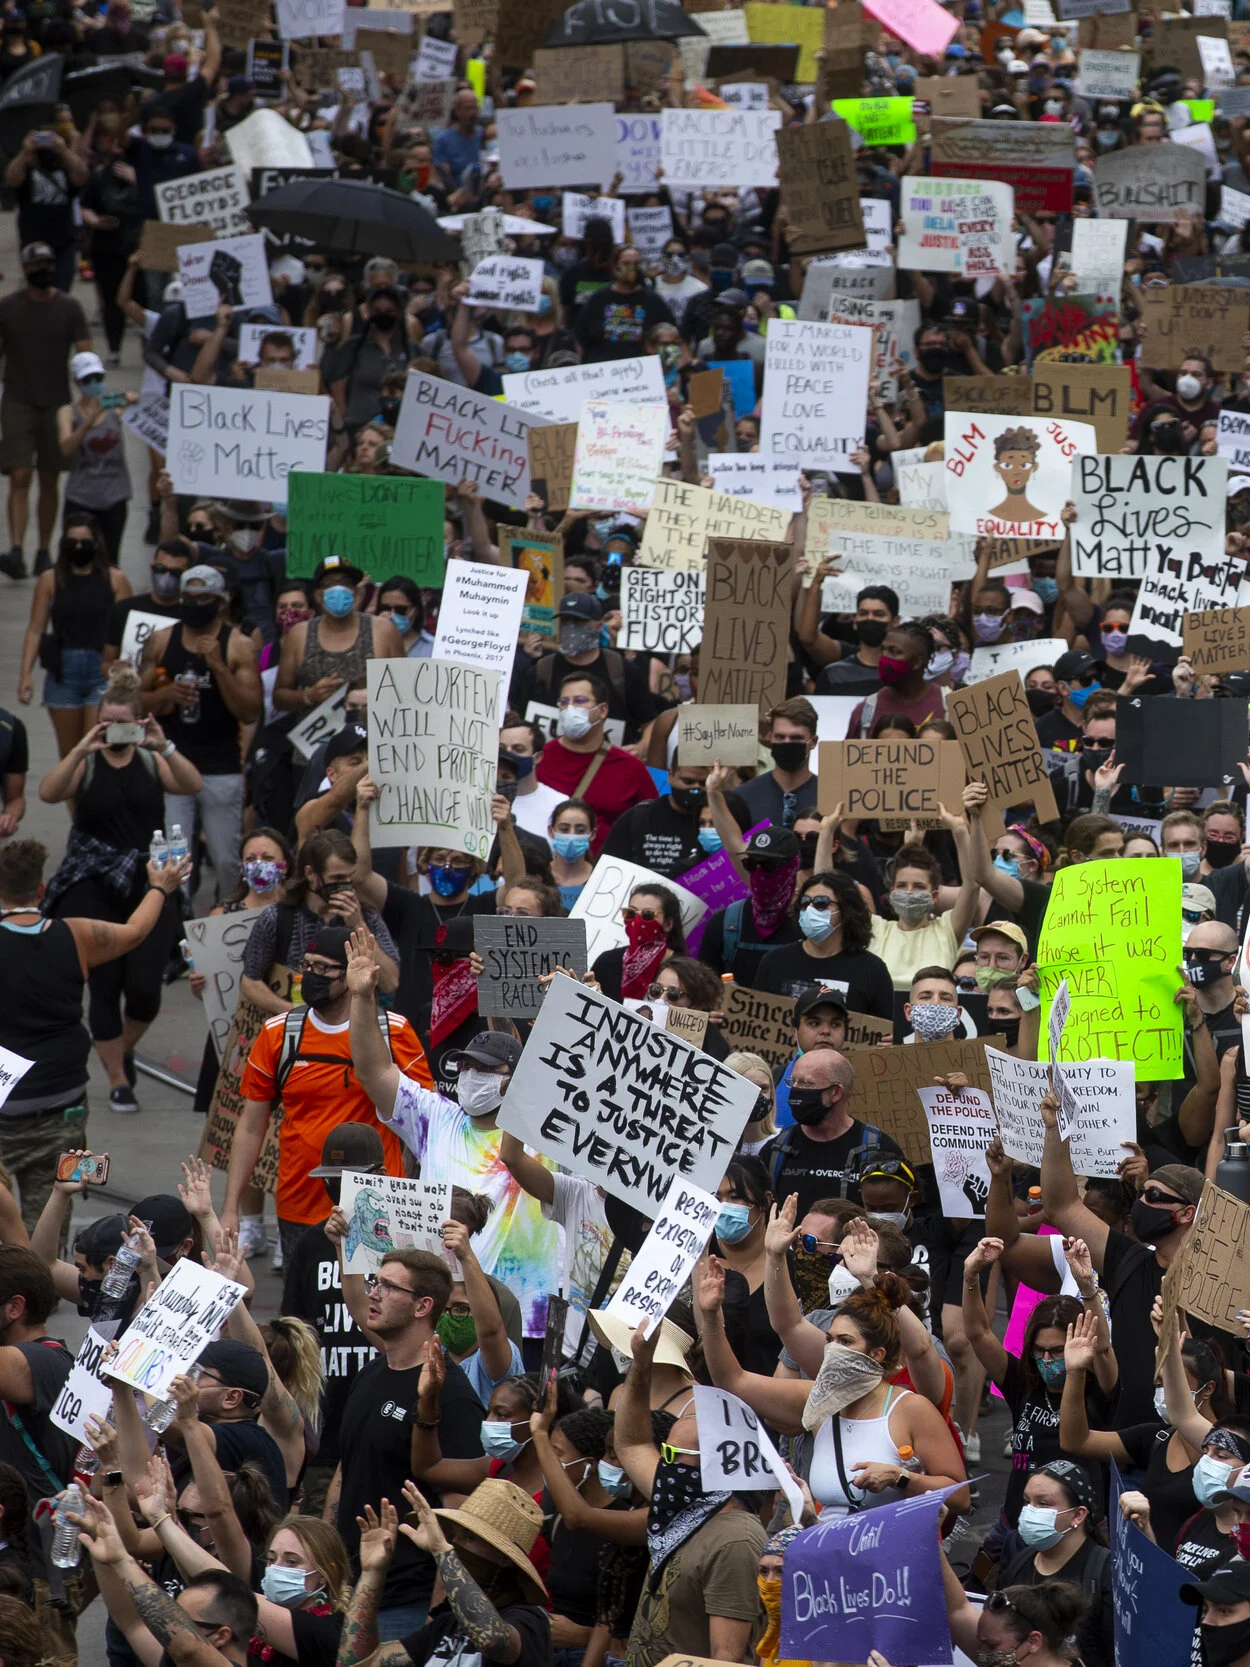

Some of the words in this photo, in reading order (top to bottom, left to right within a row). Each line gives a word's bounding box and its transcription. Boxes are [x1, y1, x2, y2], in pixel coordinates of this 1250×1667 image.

[667, 113, 748, 137] RACISM
[757, 116, 778, 135] IS
[665, 140, 733, 156] LITTLE
[673, 161, 737, 179] ENERGY
[162, 174, 235, 202] GEORGE
[786, 375, 833, 394] PEACE
[782, 403, 825, 417] LOVE
[1034, 383, 1118, 416] BLM
[180, 390, 256, 431] Black
[266, 401, 326, 441] Lives
[772, 433, 865, 454] EQUALITY
[1080, 456, 1207, 496] BLACK
[976, 519, 1058, 537] EQUALITY
[627, 570, 667, 587] GET
[674, 571, 699, 588] ON
[844, 558, 897, 576] ALWAYS
[904, 565, 950, 580] RIGHT
[629, 587, 678, 604] RIGHT
[712, 563, 786, 610] BLACK
[1188, 609, 1243, 630] BLACK
[712, 617, 777, 666] LIVES
[1204, 626, 1245, 642] LIVES
[376, 665, 402, 702] A
[414, 662, 499, 720] CURFEW
[956, 682, 1031, 735] BLACK
[847, 743, 934, 766] DEFUND
[964, 718, 1036, 768] LIVES
[871, 768, 907, 785] THE
[849, 788, 935, 811] POLICE
[1047, 906, 1098, 931] Cannot
[1110, 899, 1149, 927] Fail
[505, 923, 538, 948] END
[669, 1009, 704, 1032] UNITED
[539, 1042, 585, 1079] IS
[597, 1074, 618, 1094] A
[627, 1088, 729, 1158] THREAT
[935, 1093, 981, 1106] DEFUND
[930, 1105, 953, 1116] THE
[955, 1106, 992, 1120] POLICE
[557, 1080, 589, 1113] TO
[597, 1100, 696, 1174] JUSTICE
[931, 1123, 971, 1135] DEFEND
[973, 1125, 997, 1137] THE
[1180, 1275, 1243, 1323] POLICE
[112, 1336, 172, 1392] COLORS
[849, 1521, 884, 1556] Until
[792, 1570, 839, 1621] Black
[840, 1575, 871, 1613] Lives
[872, 1566, 912, 1607] Do!!
